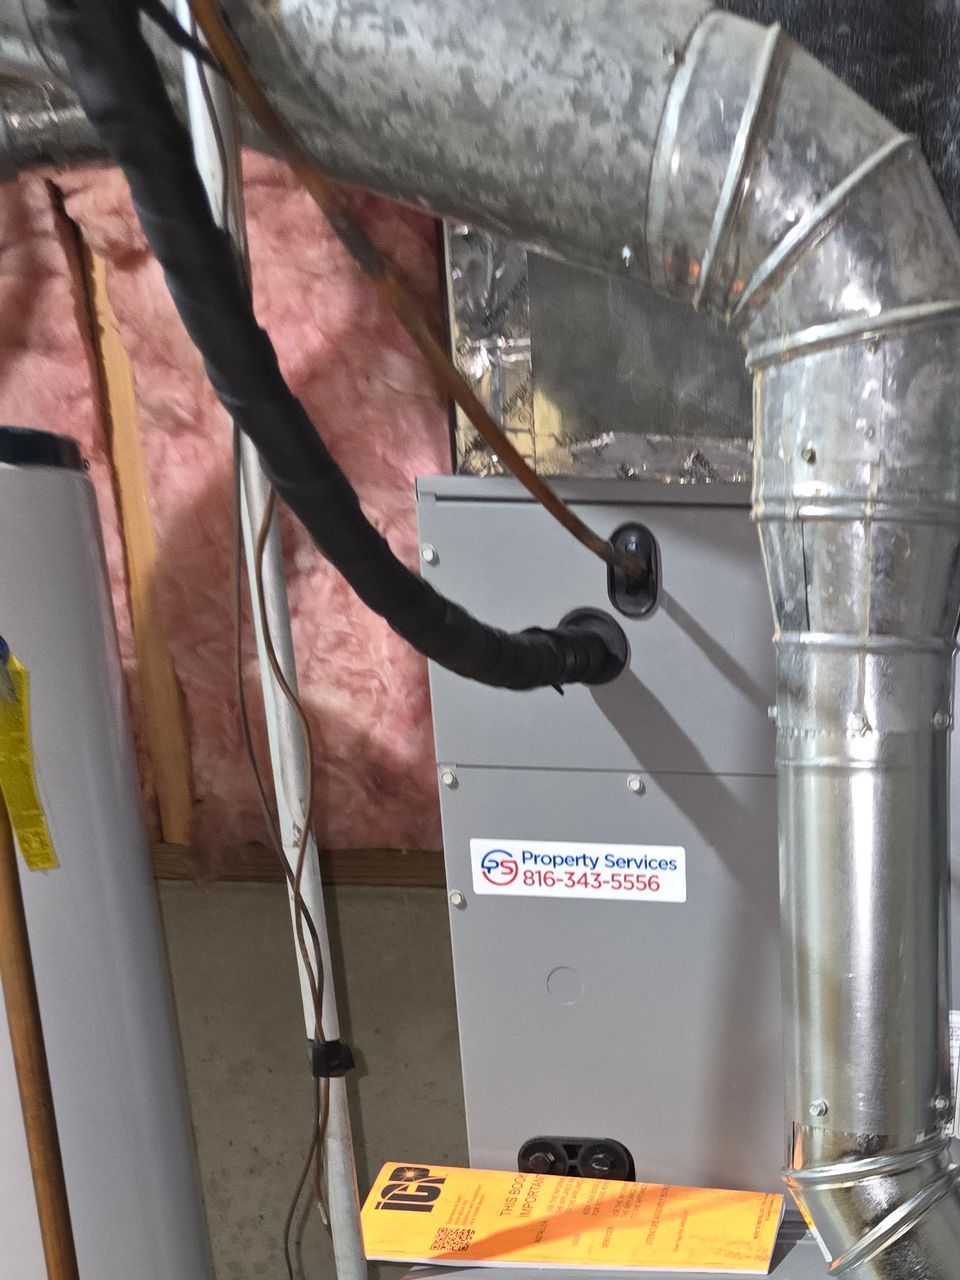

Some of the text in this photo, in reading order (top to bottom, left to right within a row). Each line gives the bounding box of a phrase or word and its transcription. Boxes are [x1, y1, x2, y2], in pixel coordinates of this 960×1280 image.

[522, 850, 677, 871] Property Services
[523, 869, 660, 892] 816-343-5556
